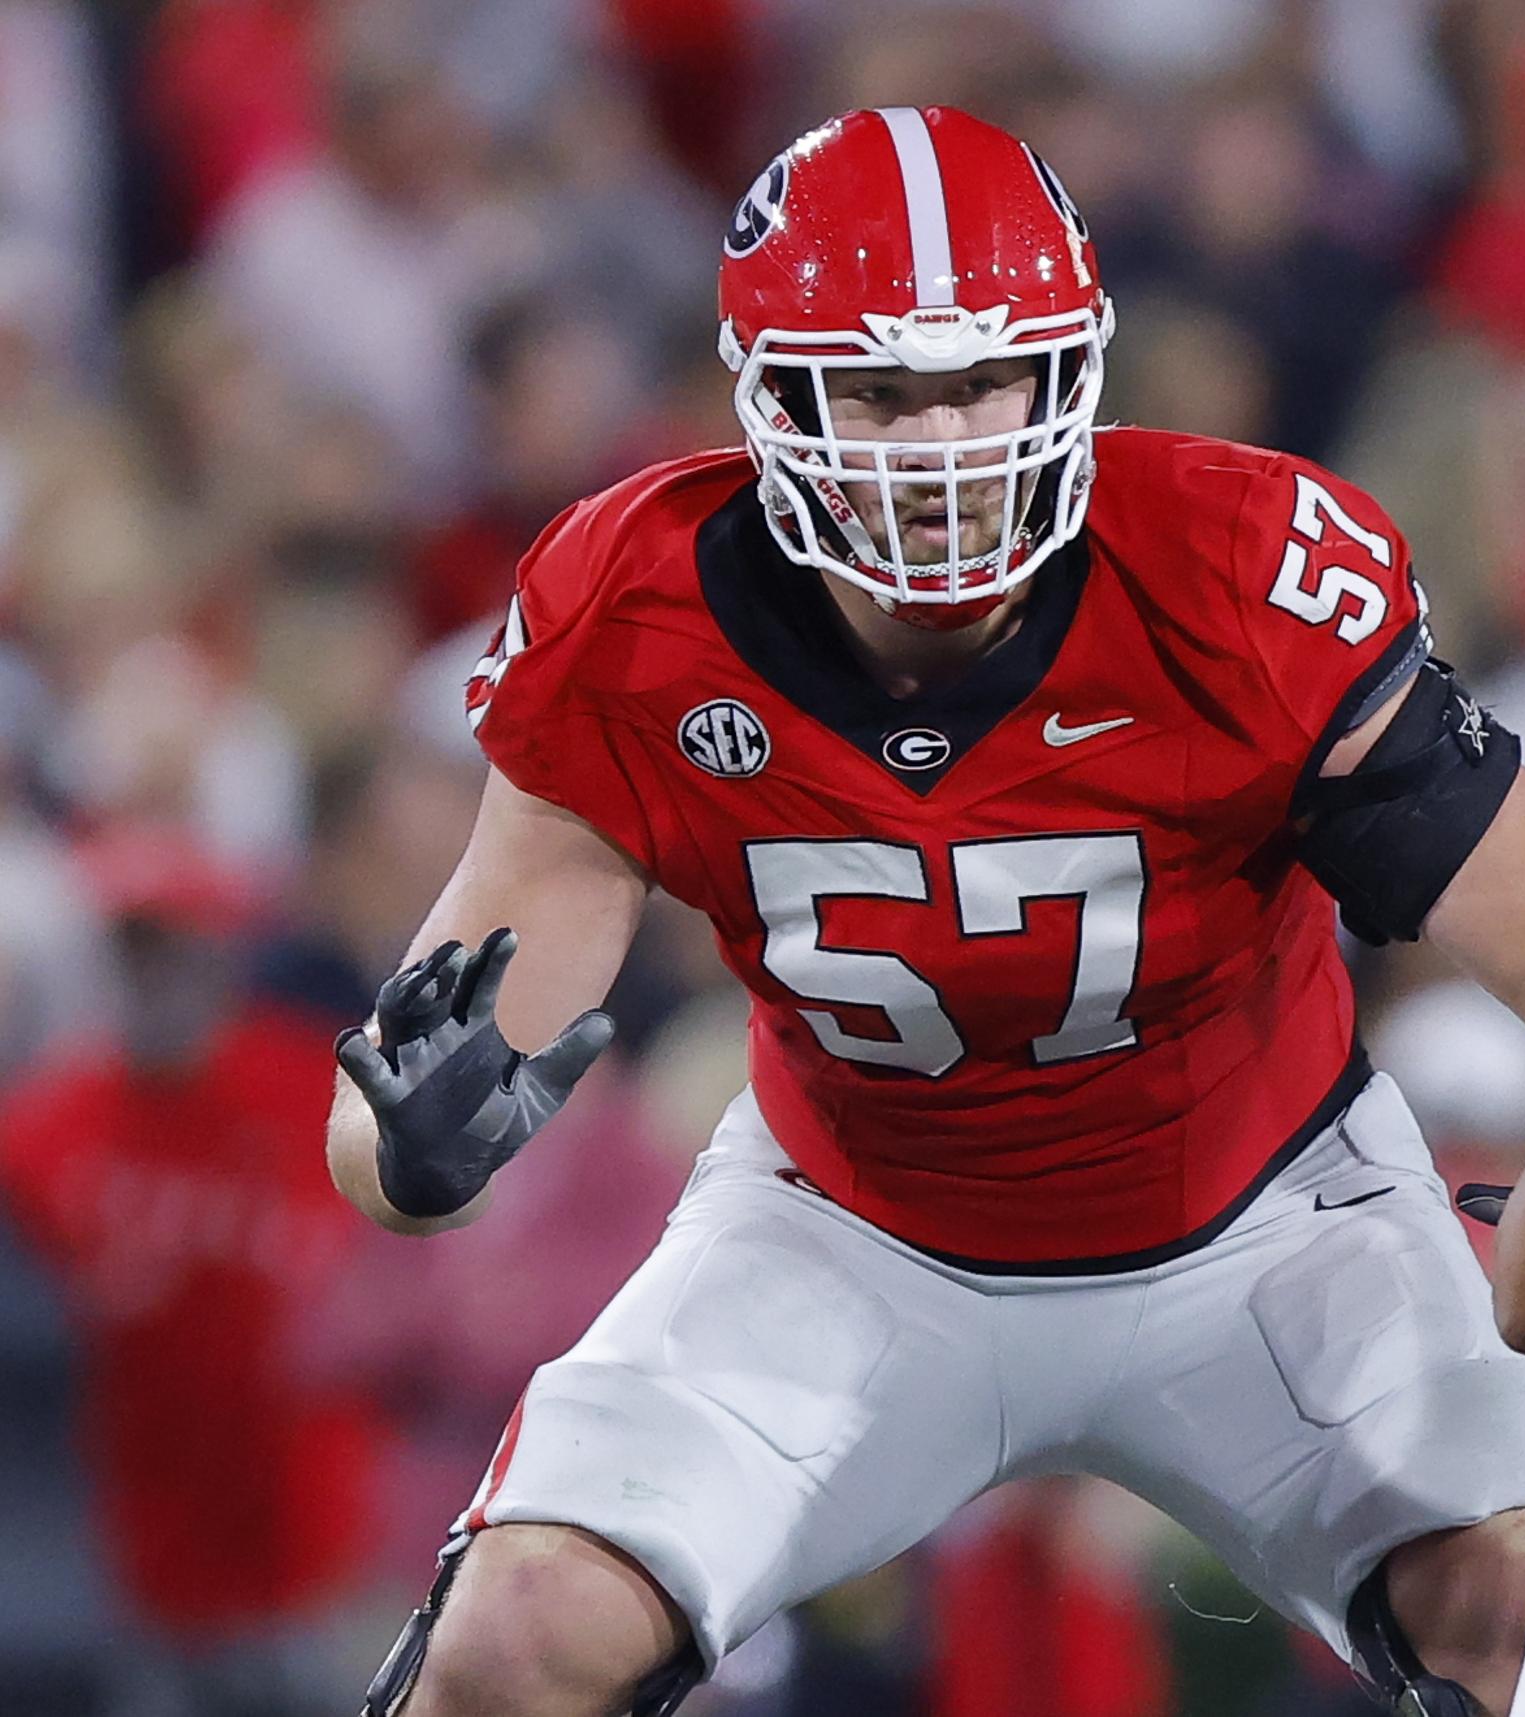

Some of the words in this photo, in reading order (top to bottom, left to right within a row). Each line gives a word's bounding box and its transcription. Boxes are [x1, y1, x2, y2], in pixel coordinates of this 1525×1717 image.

[1265, 472, 1393, 647] 57
[684, 705, 764, 774] SEC
[741, 828, 1147, 1079] 57
